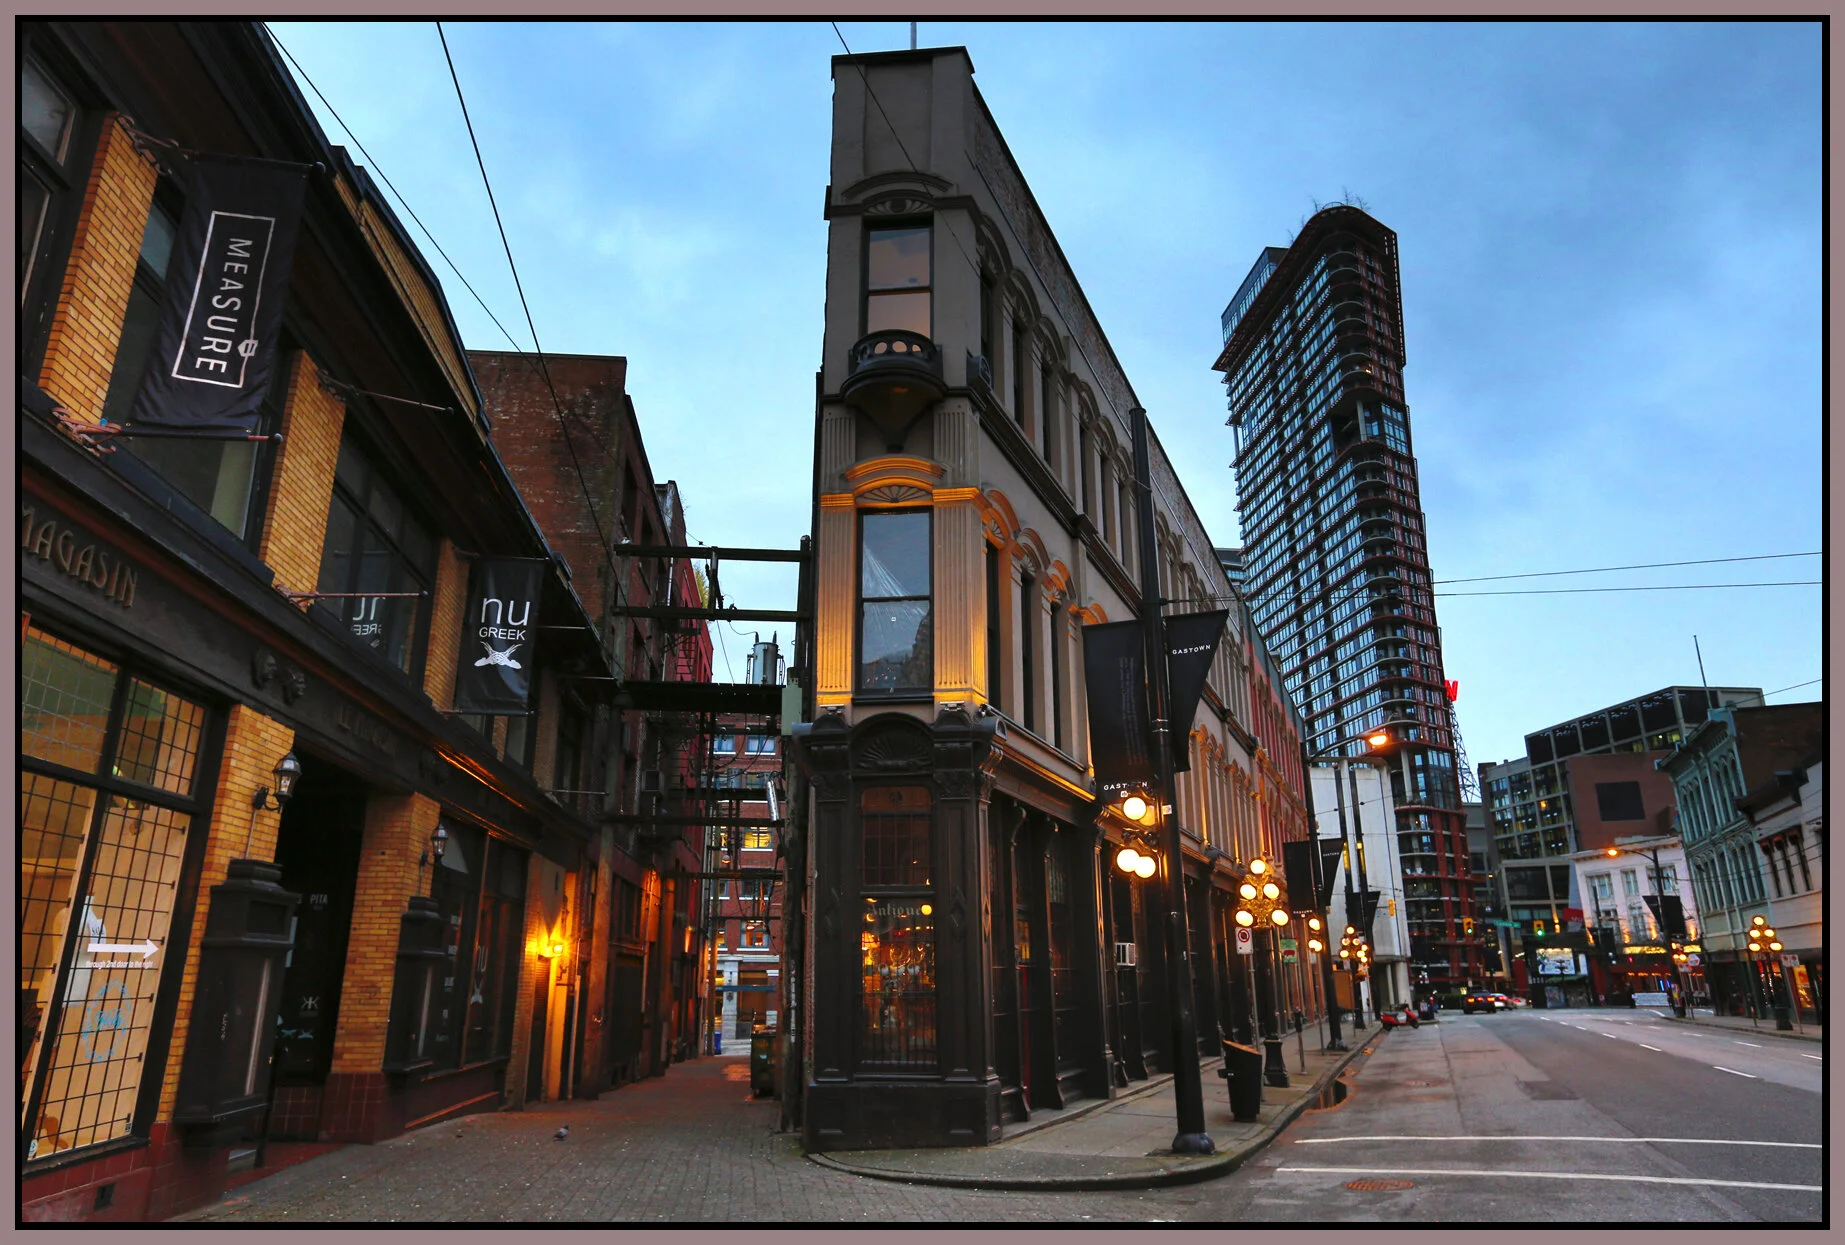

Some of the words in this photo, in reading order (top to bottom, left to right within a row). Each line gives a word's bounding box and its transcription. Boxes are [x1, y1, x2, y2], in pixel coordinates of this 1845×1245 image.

[194, 237, 254, 374] MEASURE
[480, 597, 531, 627] nu
[478, 626, 526, 641] GREEK
[1172, 644, 1211, 655] GASTOWN
[1103, 780, 1148, 791] GASTN
[310, 894, 328, 905] PITA
